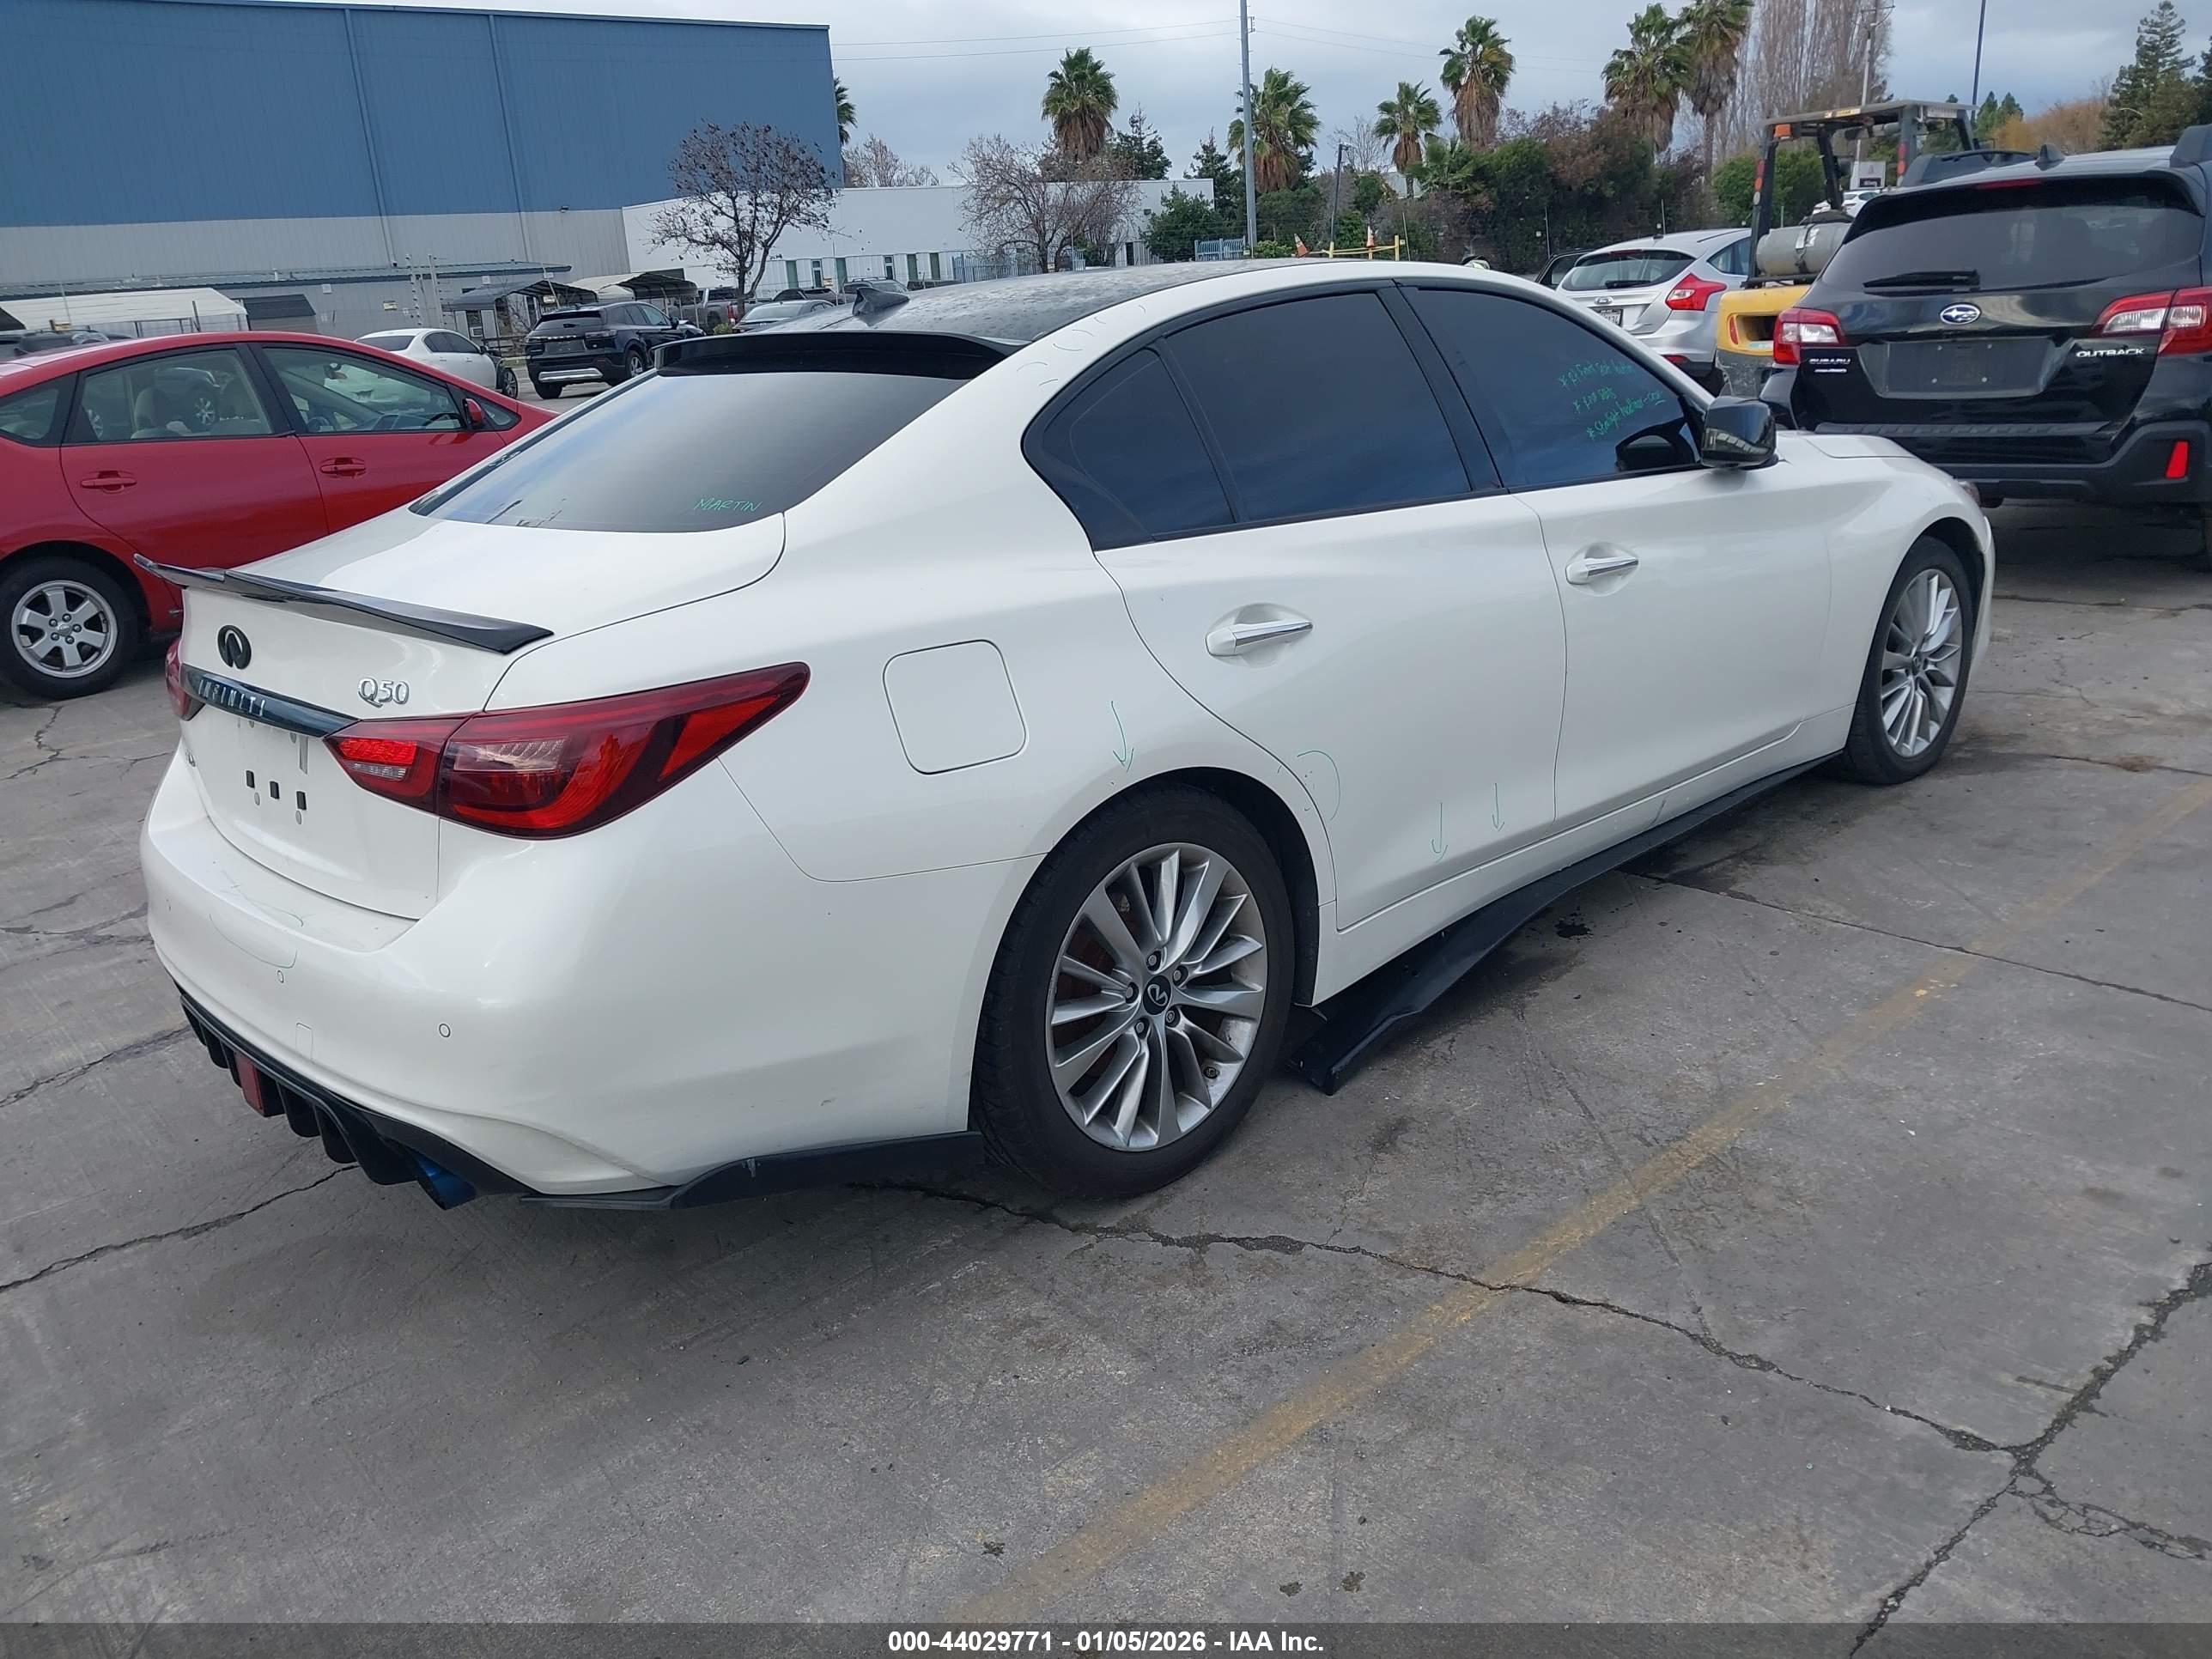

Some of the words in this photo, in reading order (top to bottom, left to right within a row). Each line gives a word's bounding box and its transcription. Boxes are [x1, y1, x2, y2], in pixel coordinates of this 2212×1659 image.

[2075, 348, 2146, 357] OUTBACK
[693, 497, 763, 512] MARTIN
[198, 679, 265, 716] INFINITI
[357, 677, 410, 708] Q50
